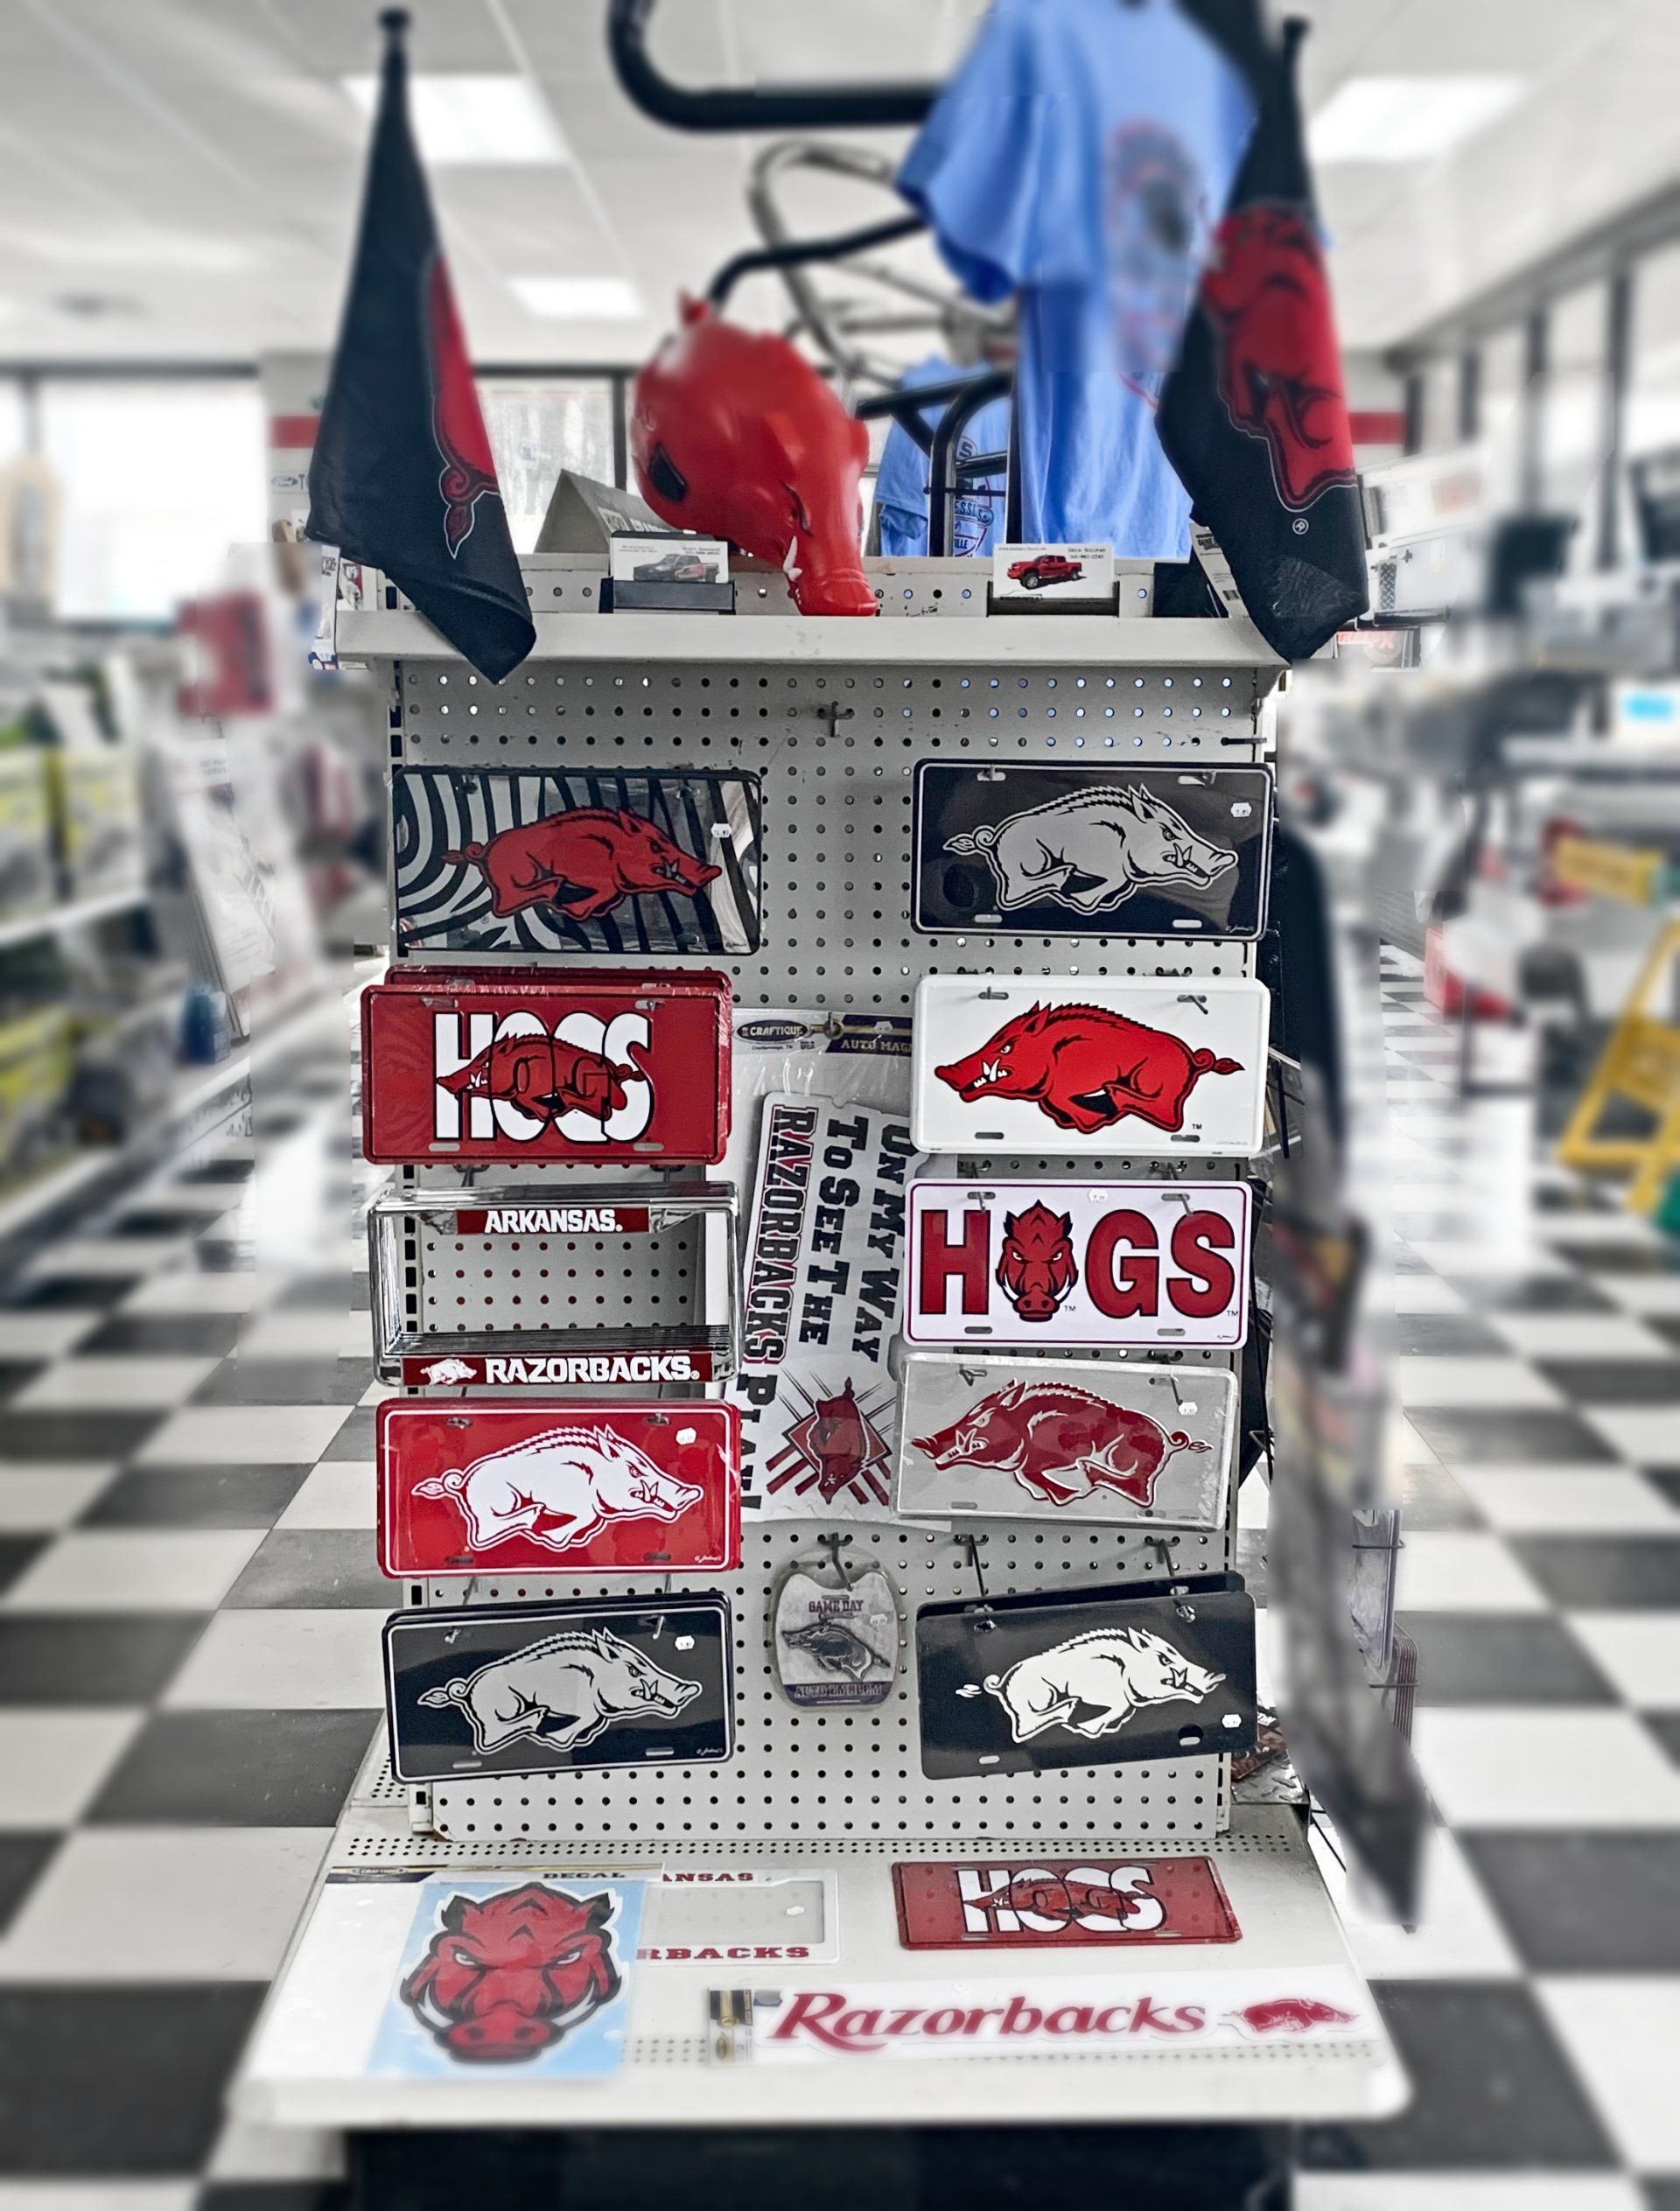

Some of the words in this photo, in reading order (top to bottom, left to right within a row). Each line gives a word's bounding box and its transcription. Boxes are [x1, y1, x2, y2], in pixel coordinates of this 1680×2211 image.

[750, 1025, 803, 1036] CRAFTIQUE
[435, 1009, 654, 1143] HOGS
[878, 1123, 919, 1185] ON
[743, 1104, 818, 1364] RAZORBACKS
[811, 1176, 860, 1255] SEE
[867, 1188, 906, 1259] MY
[799, 1260, 850, 1346] THE
[852, 1267, 900, 1363] WAY
[843, 1599, 864, 1612] DAY
[956, 1866, 1167, 1933] HOGS
[766, 1992, 1207, 2052] Razorbacks
